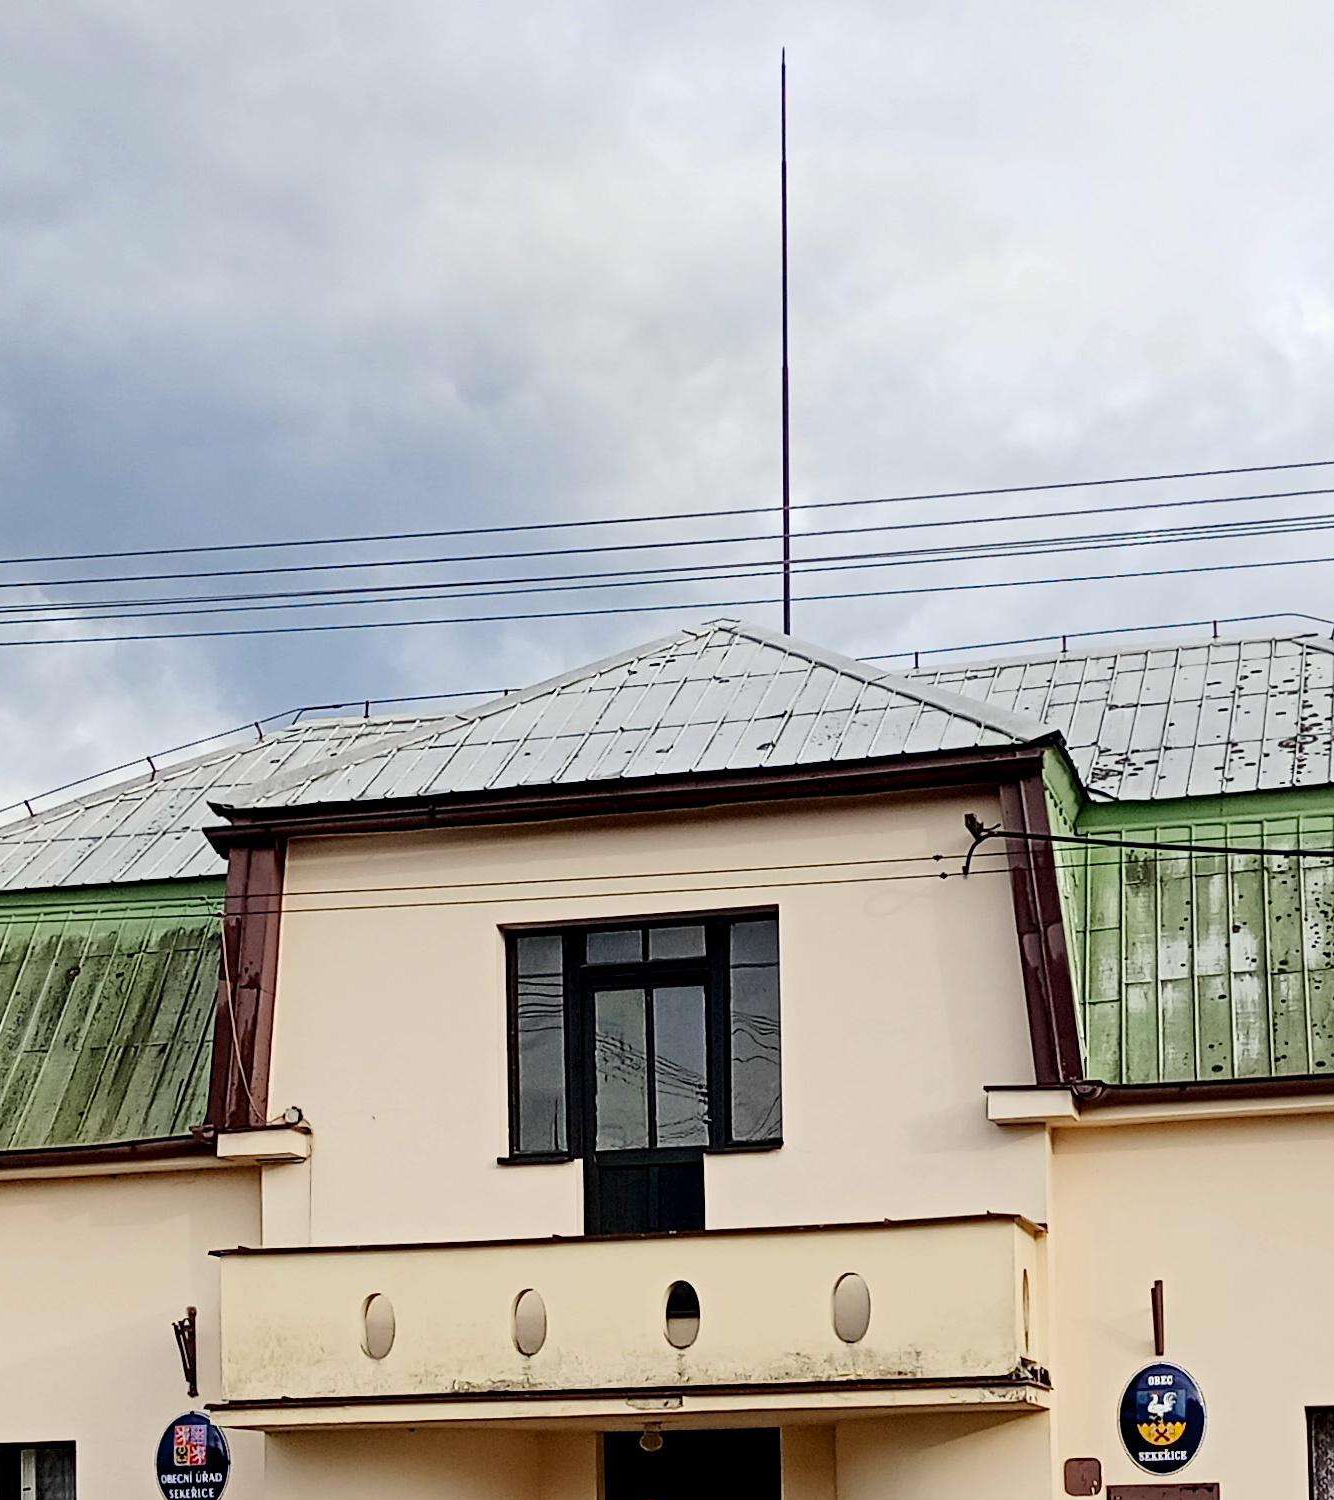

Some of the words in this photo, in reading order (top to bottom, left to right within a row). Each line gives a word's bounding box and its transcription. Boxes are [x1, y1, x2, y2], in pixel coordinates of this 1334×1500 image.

[1147, 1375, 1173, 1386] OBEC
[1138, 1449, 1188, 1462] SEKEŘICE
[160, 1470, 193, 1484] OBECNÍ
[195, 1470, 223, 1483] ÚŘAD
[169, 1486, 215, 1499] SEKEŘICE
